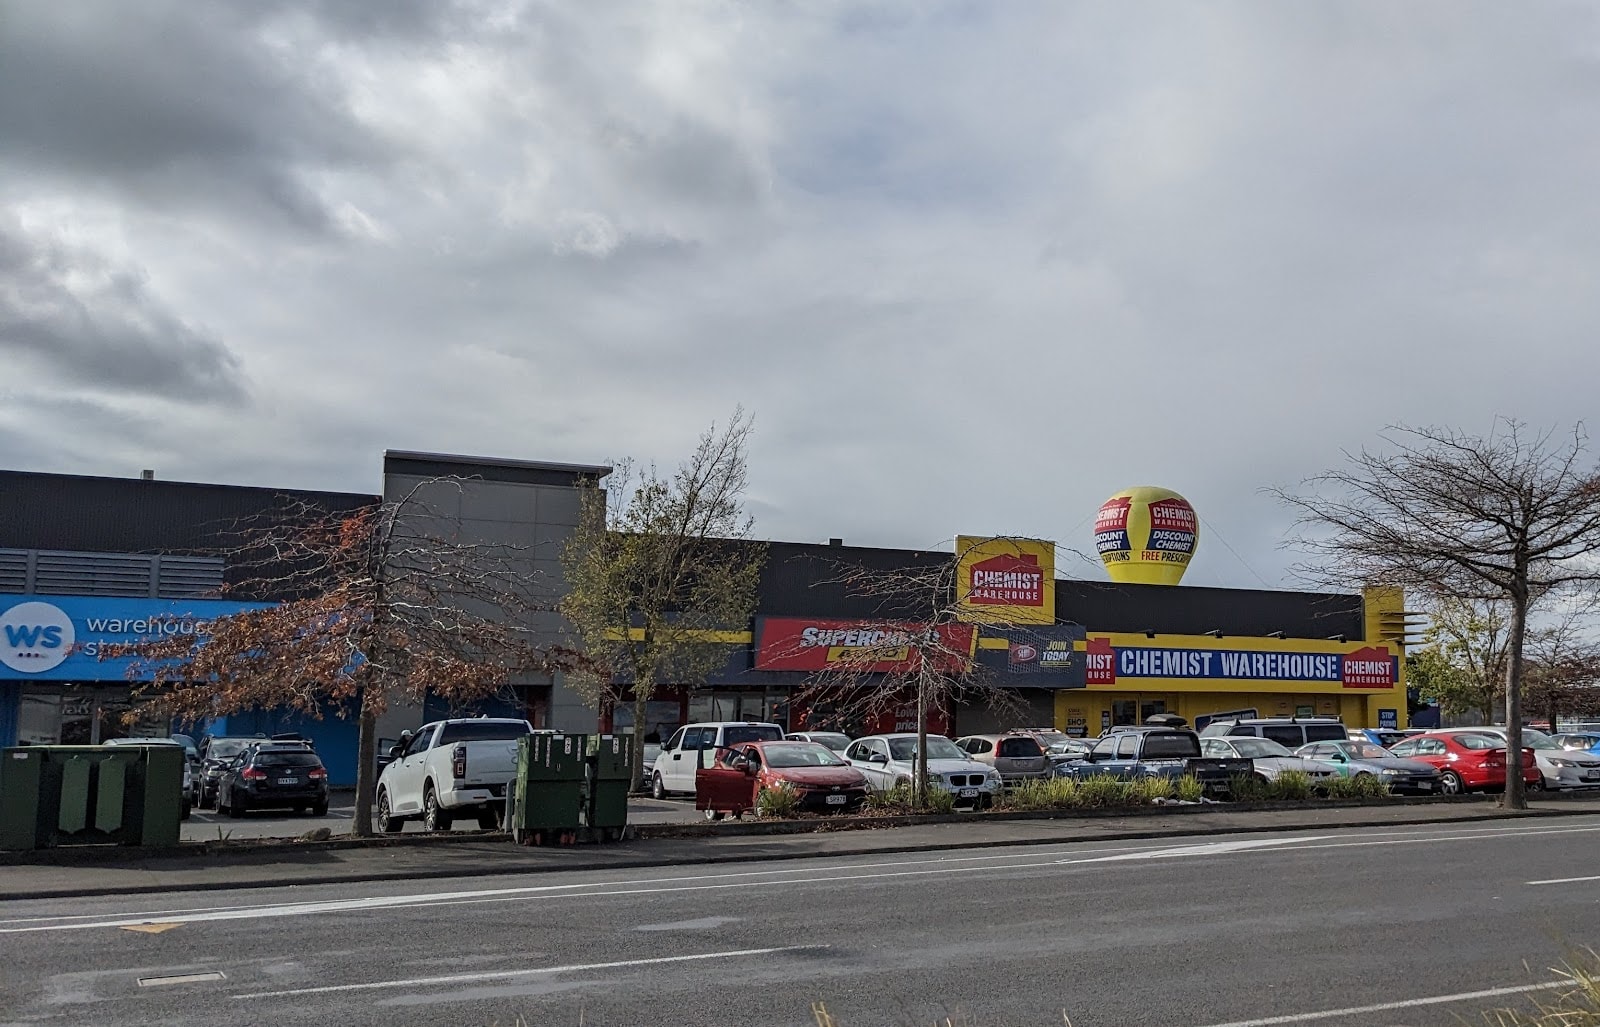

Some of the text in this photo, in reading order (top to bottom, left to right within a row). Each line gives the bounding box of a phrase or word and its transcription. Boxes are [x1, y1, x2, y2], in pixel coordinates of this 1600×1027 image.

[1153, 507, 1194, 521] CHEMIST
[1154, 519, 1194, 528] WAREHOUSE
[1153, 531, 1194, 542] DISCOUNT
[1156, 540, 1191, 551] CHEMIST
[1141, 551, 1160, 560] FREE
[974, 570, 1040, 590] CHEMIST
[974, 590, 1038, 600] WAREHOUSE
[5, 624, 63, 649] WS
[1046, 641, 1067, 651] JOIN
[1042, 651, 1070, 661] TODAY
[1121, 650, 1337, 679] CHEMIST WAREHOUSE
[1344, 661, 1391, 675] CHEMIST
